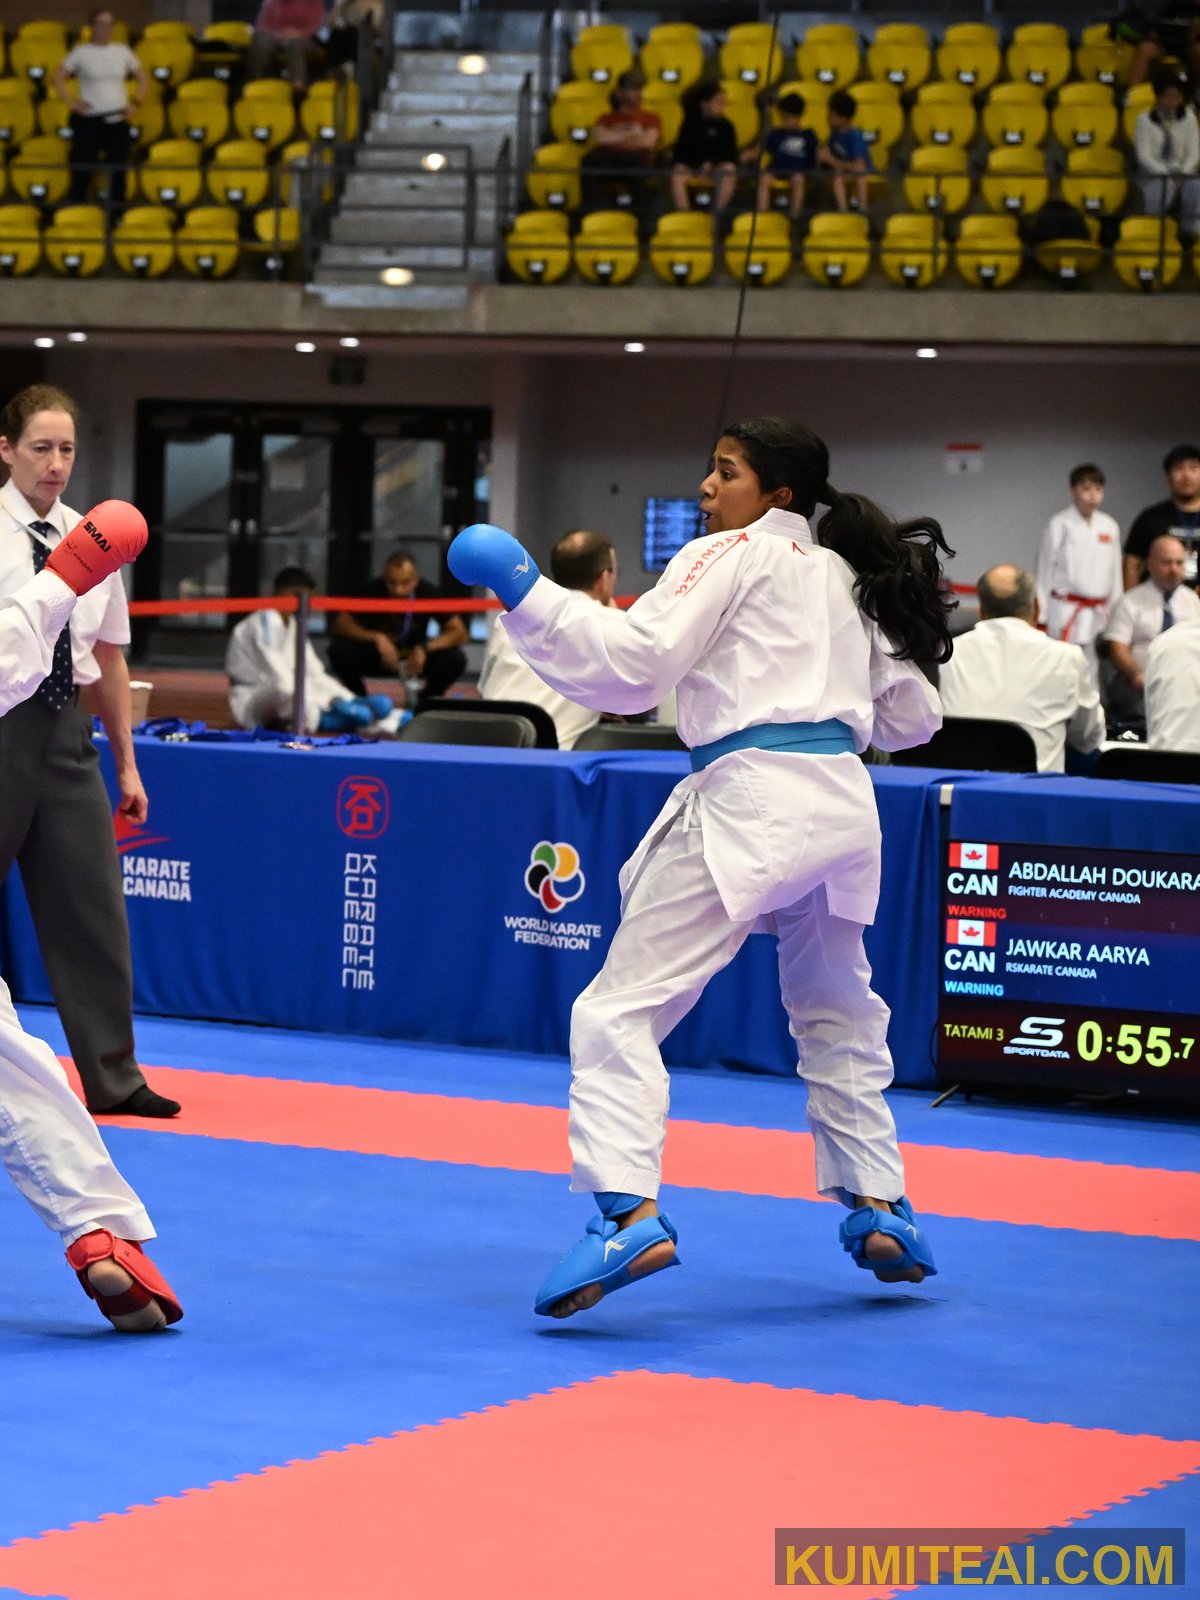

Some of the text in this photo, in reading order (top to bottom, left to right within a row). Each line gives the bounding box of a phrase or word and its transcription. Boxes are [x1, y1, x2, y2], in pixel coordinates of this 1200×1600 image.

[83, 521, 112, 553] SMAI
[123, 855, 191, 881] KARATE
[1008, 861, 1106, 885] ABDALLAH
[122, 876, 192, 902] CANADA
[947, 872, 998, 896] CAN
[1008, 885, 1141, 904] FIGHTER ACADEMY CANADA
[947, 904, 1007, 919] WARNING
[504, 915, 602, 938] WORLD KARATE
[514, 930, 590, 950] FEDERATION
[944, 948, 995, 973] CAN
[1005, 938, 1150, 966] JAWKAR AARYA
[1005, 962, 1097, 979] RSKARATE CANADA
[944, 980, 1004, 997] WARNING
[943, 1023, 1004, 1042] TATAMI 3
[1003, 1046, 1071, 1059] SPORTDATA
